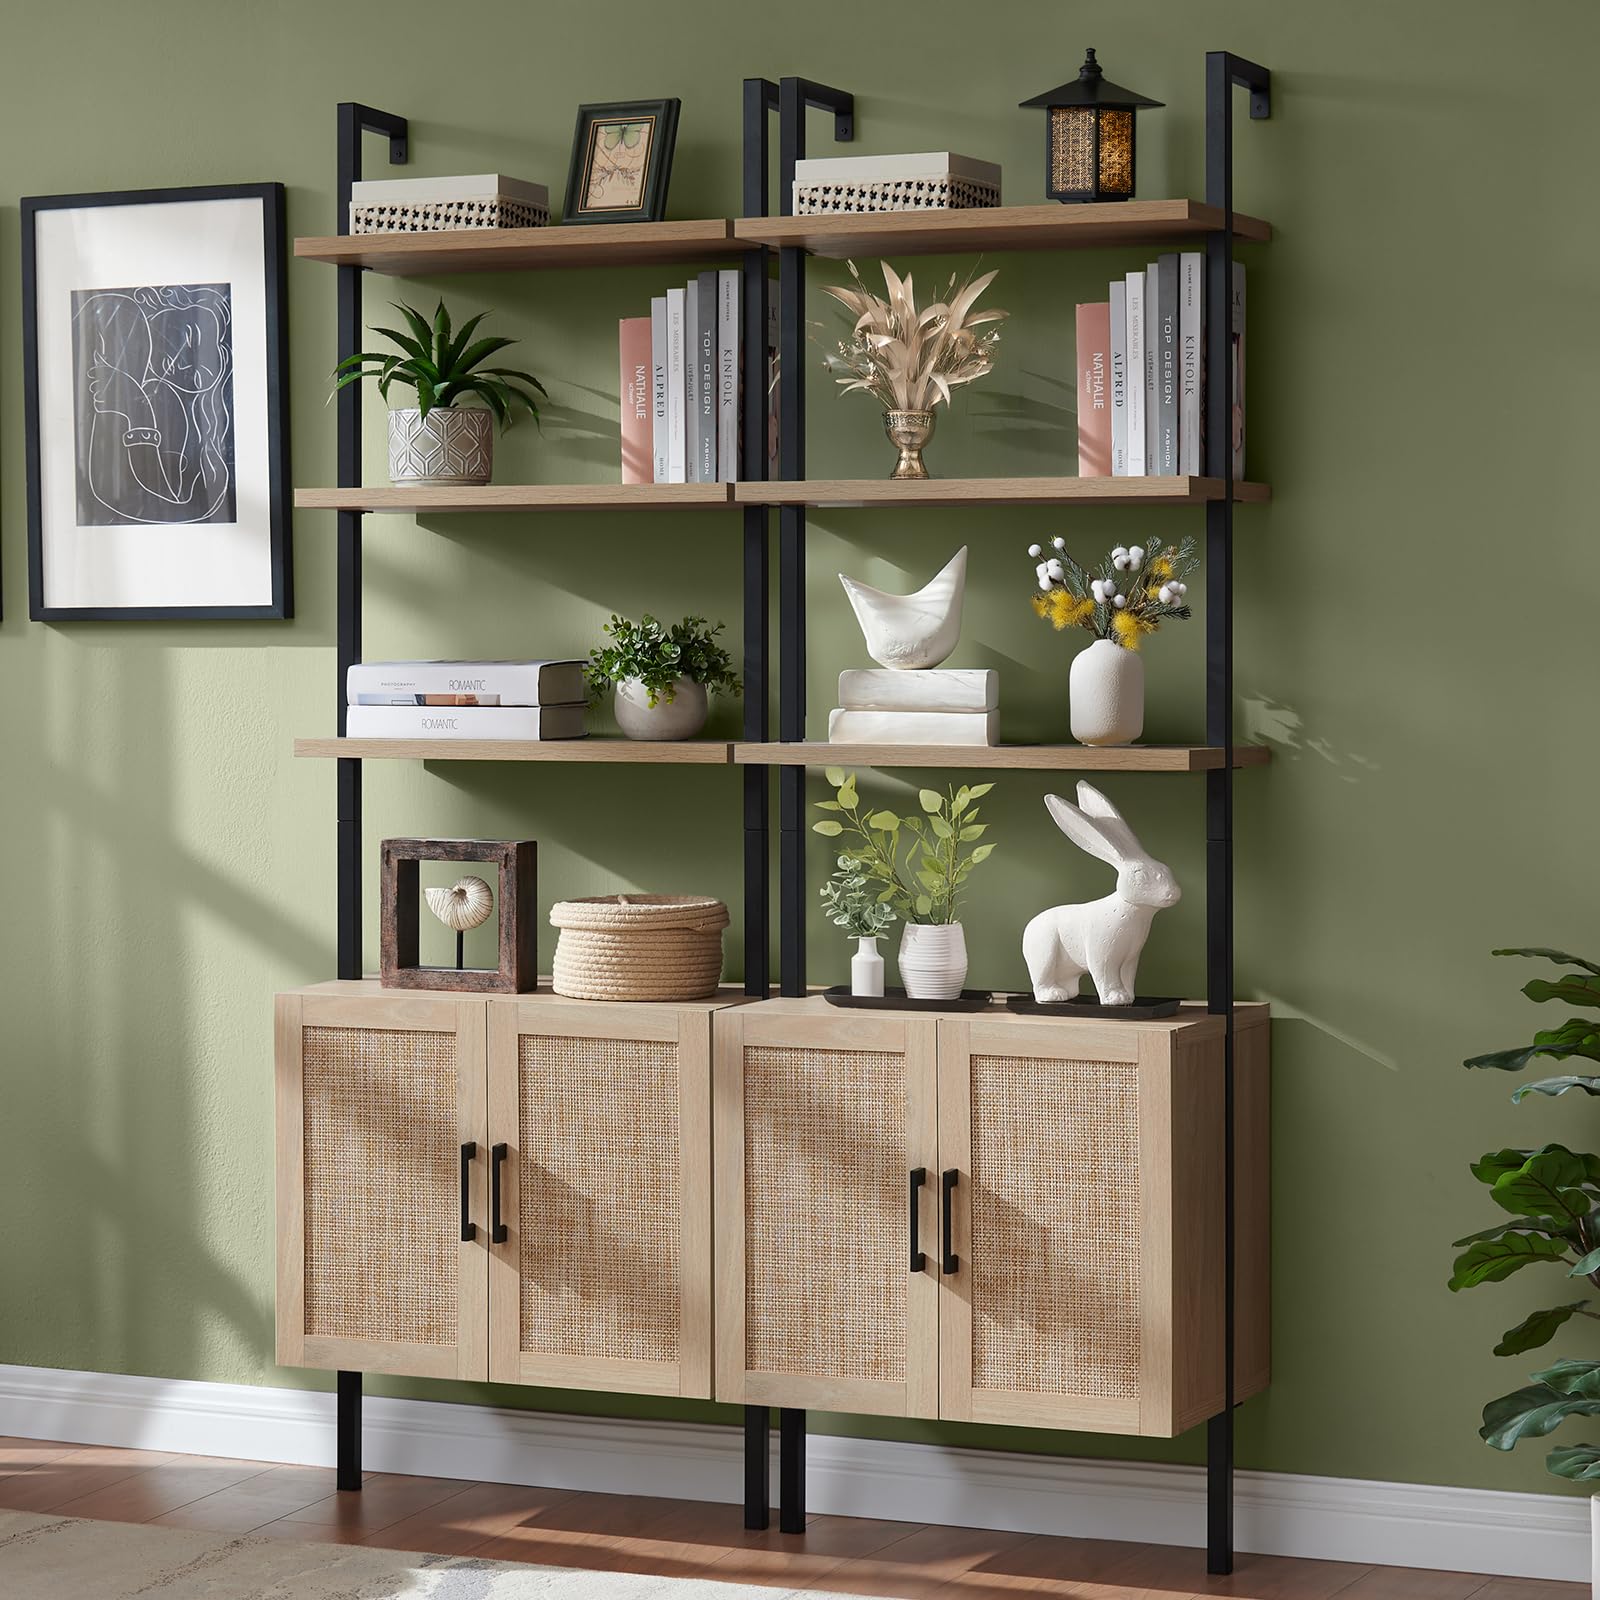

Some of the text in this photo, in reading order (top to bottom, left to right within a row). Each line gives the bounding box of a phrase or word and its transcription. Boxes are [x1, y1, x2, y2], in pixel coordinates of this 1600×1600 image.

[703, 330, 711, 415] TOP DESIGN
[723, 349, 732, 406] KINFOLK
[1093, 352, 1105, 409] NATHALIE
[1114, 351, 1124, 408] ALPRED
[1164, 315, 1172, 404] TOP DESIGN
[1185, 335, 1194, 395] KINFOLK
[635, 365, 647, 419] NATHALIE
[655, 364, 665, 418] ALPRED
[448, 679, 486, 691] ROMANTIC
[421, 718, 458, 730] ROMANTIC
